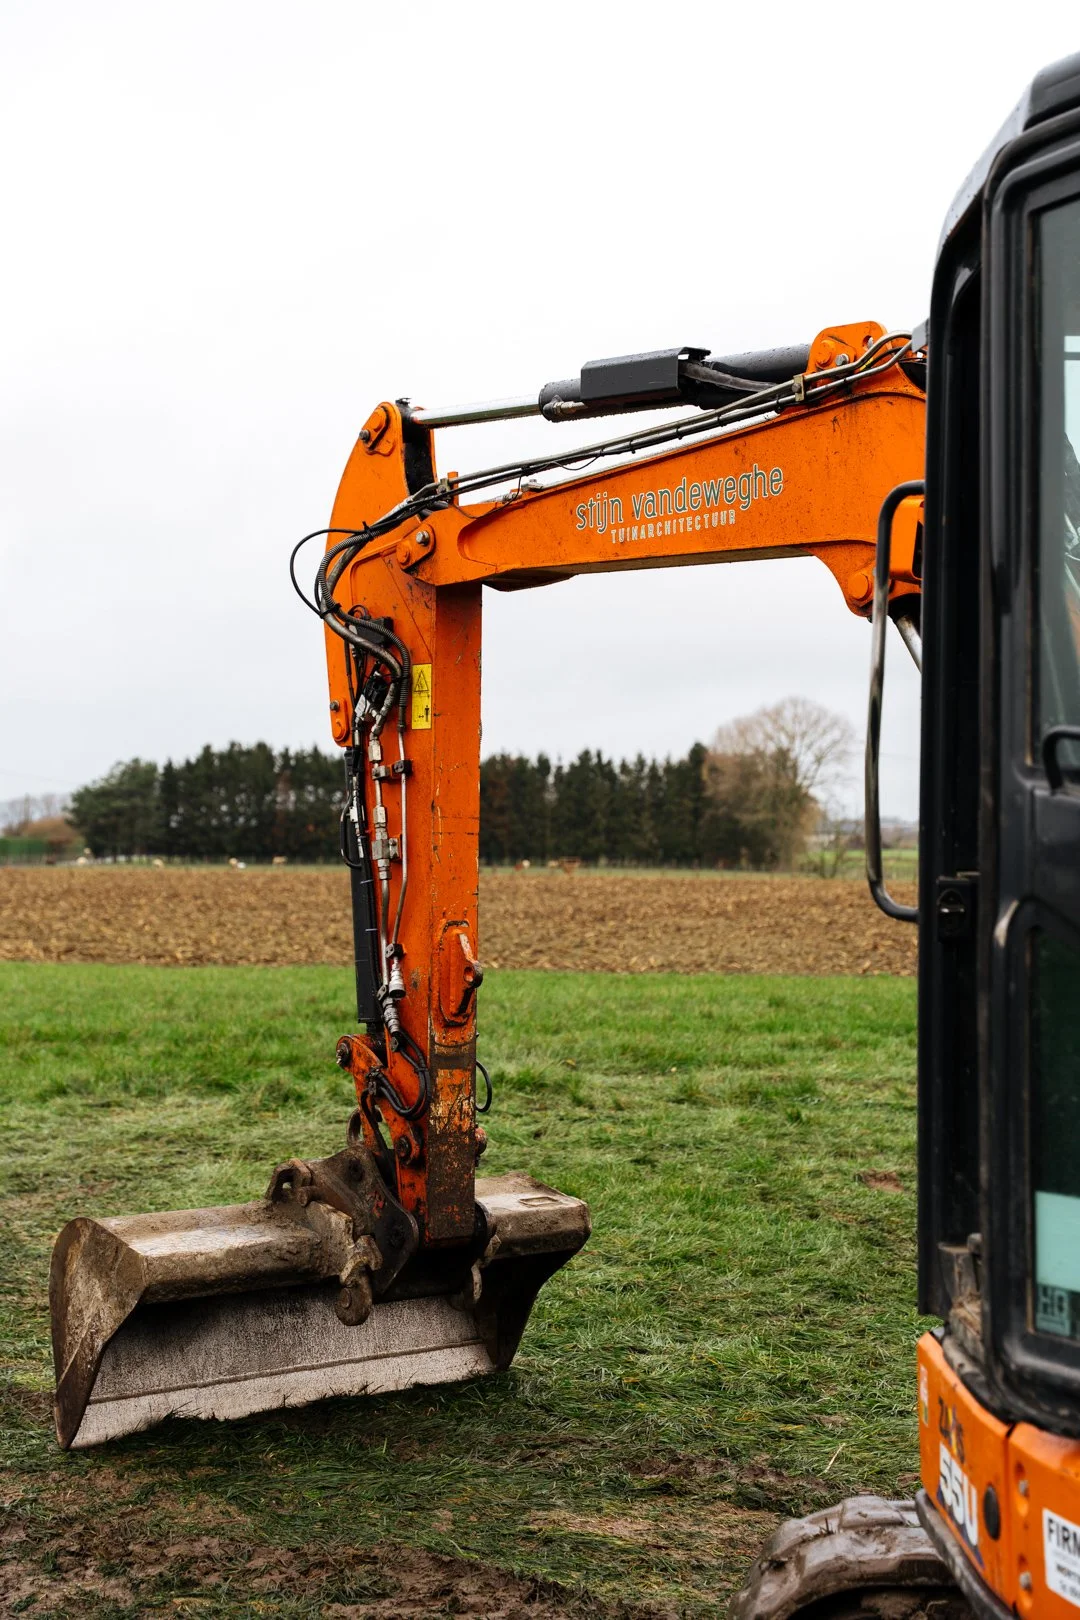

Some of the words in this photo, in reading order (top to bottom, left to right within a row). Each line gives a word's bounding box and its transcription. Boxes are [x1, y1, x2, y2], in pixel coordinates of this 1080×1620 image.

[576, 491, 624, 534] stijn
[632, 463, 783, 520] vandeweghe
[611, 509, 735, 544] TUINARCHITECTUUR
